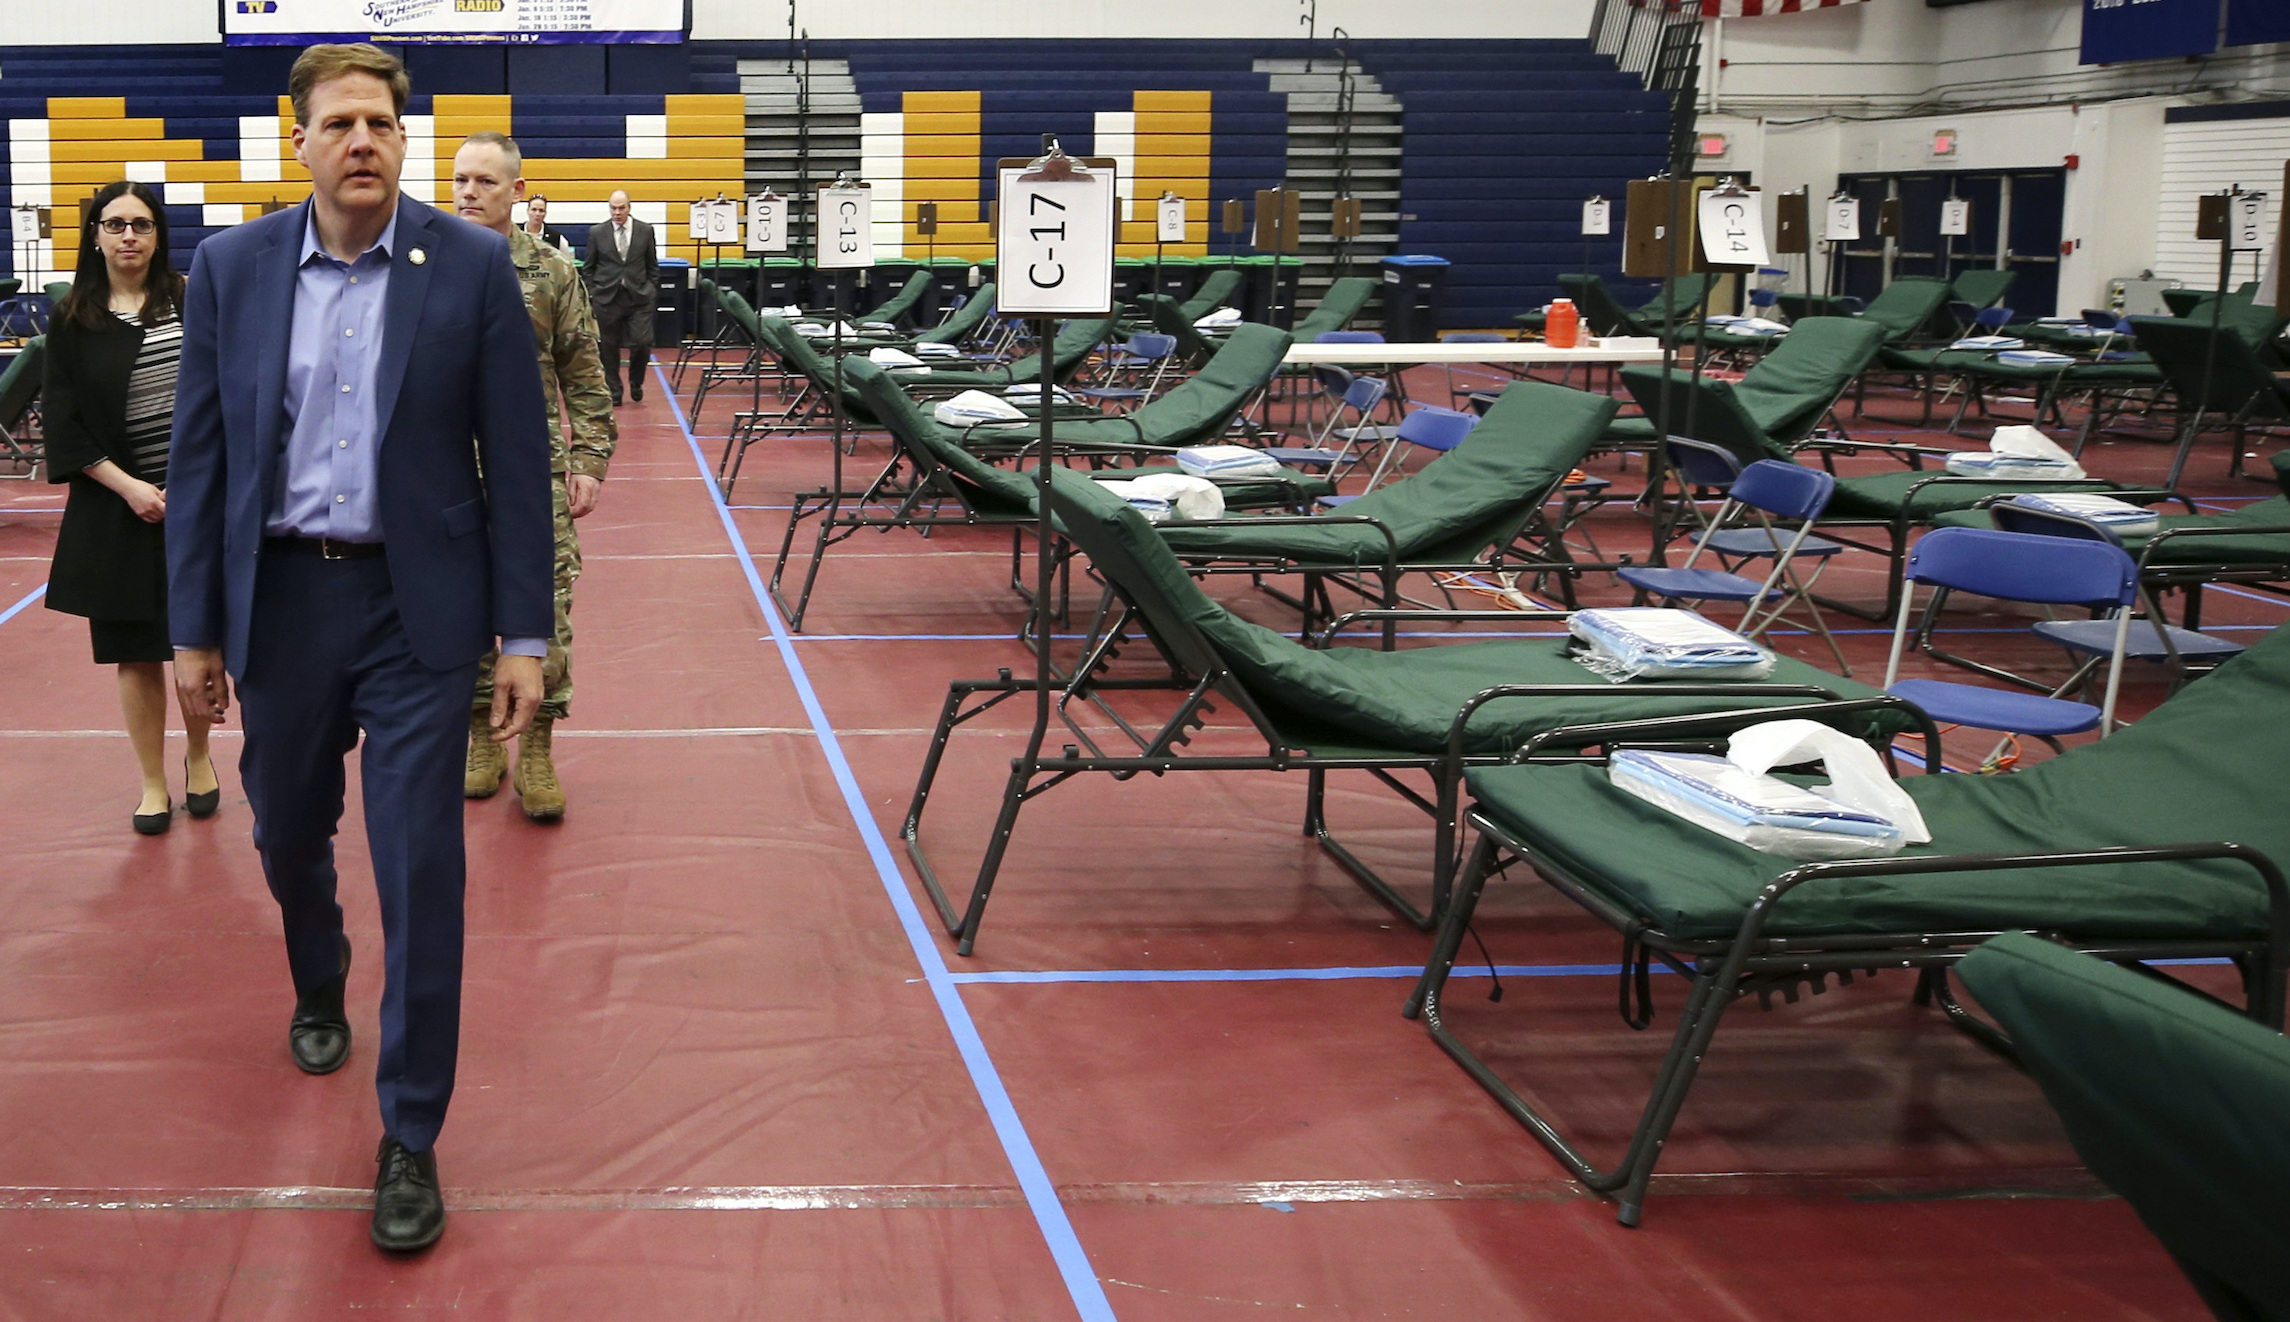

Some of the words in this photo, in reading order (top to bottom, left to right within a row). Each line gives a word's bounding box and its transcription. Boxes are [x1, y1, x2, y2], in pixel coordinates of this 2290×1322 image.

[245, 1, 265, 13] TV
[456, 0, 502, 11] RADIO
[714, 212, 725, 232] C-7
[758, 205, 772, 242] C-10
[839, 201, 858, 254] C-13
[1167, 209, 1178, 231] C-8
[1724, 203, 1749, 253] C-14
[1029, 193, 1066, 289] C-17
